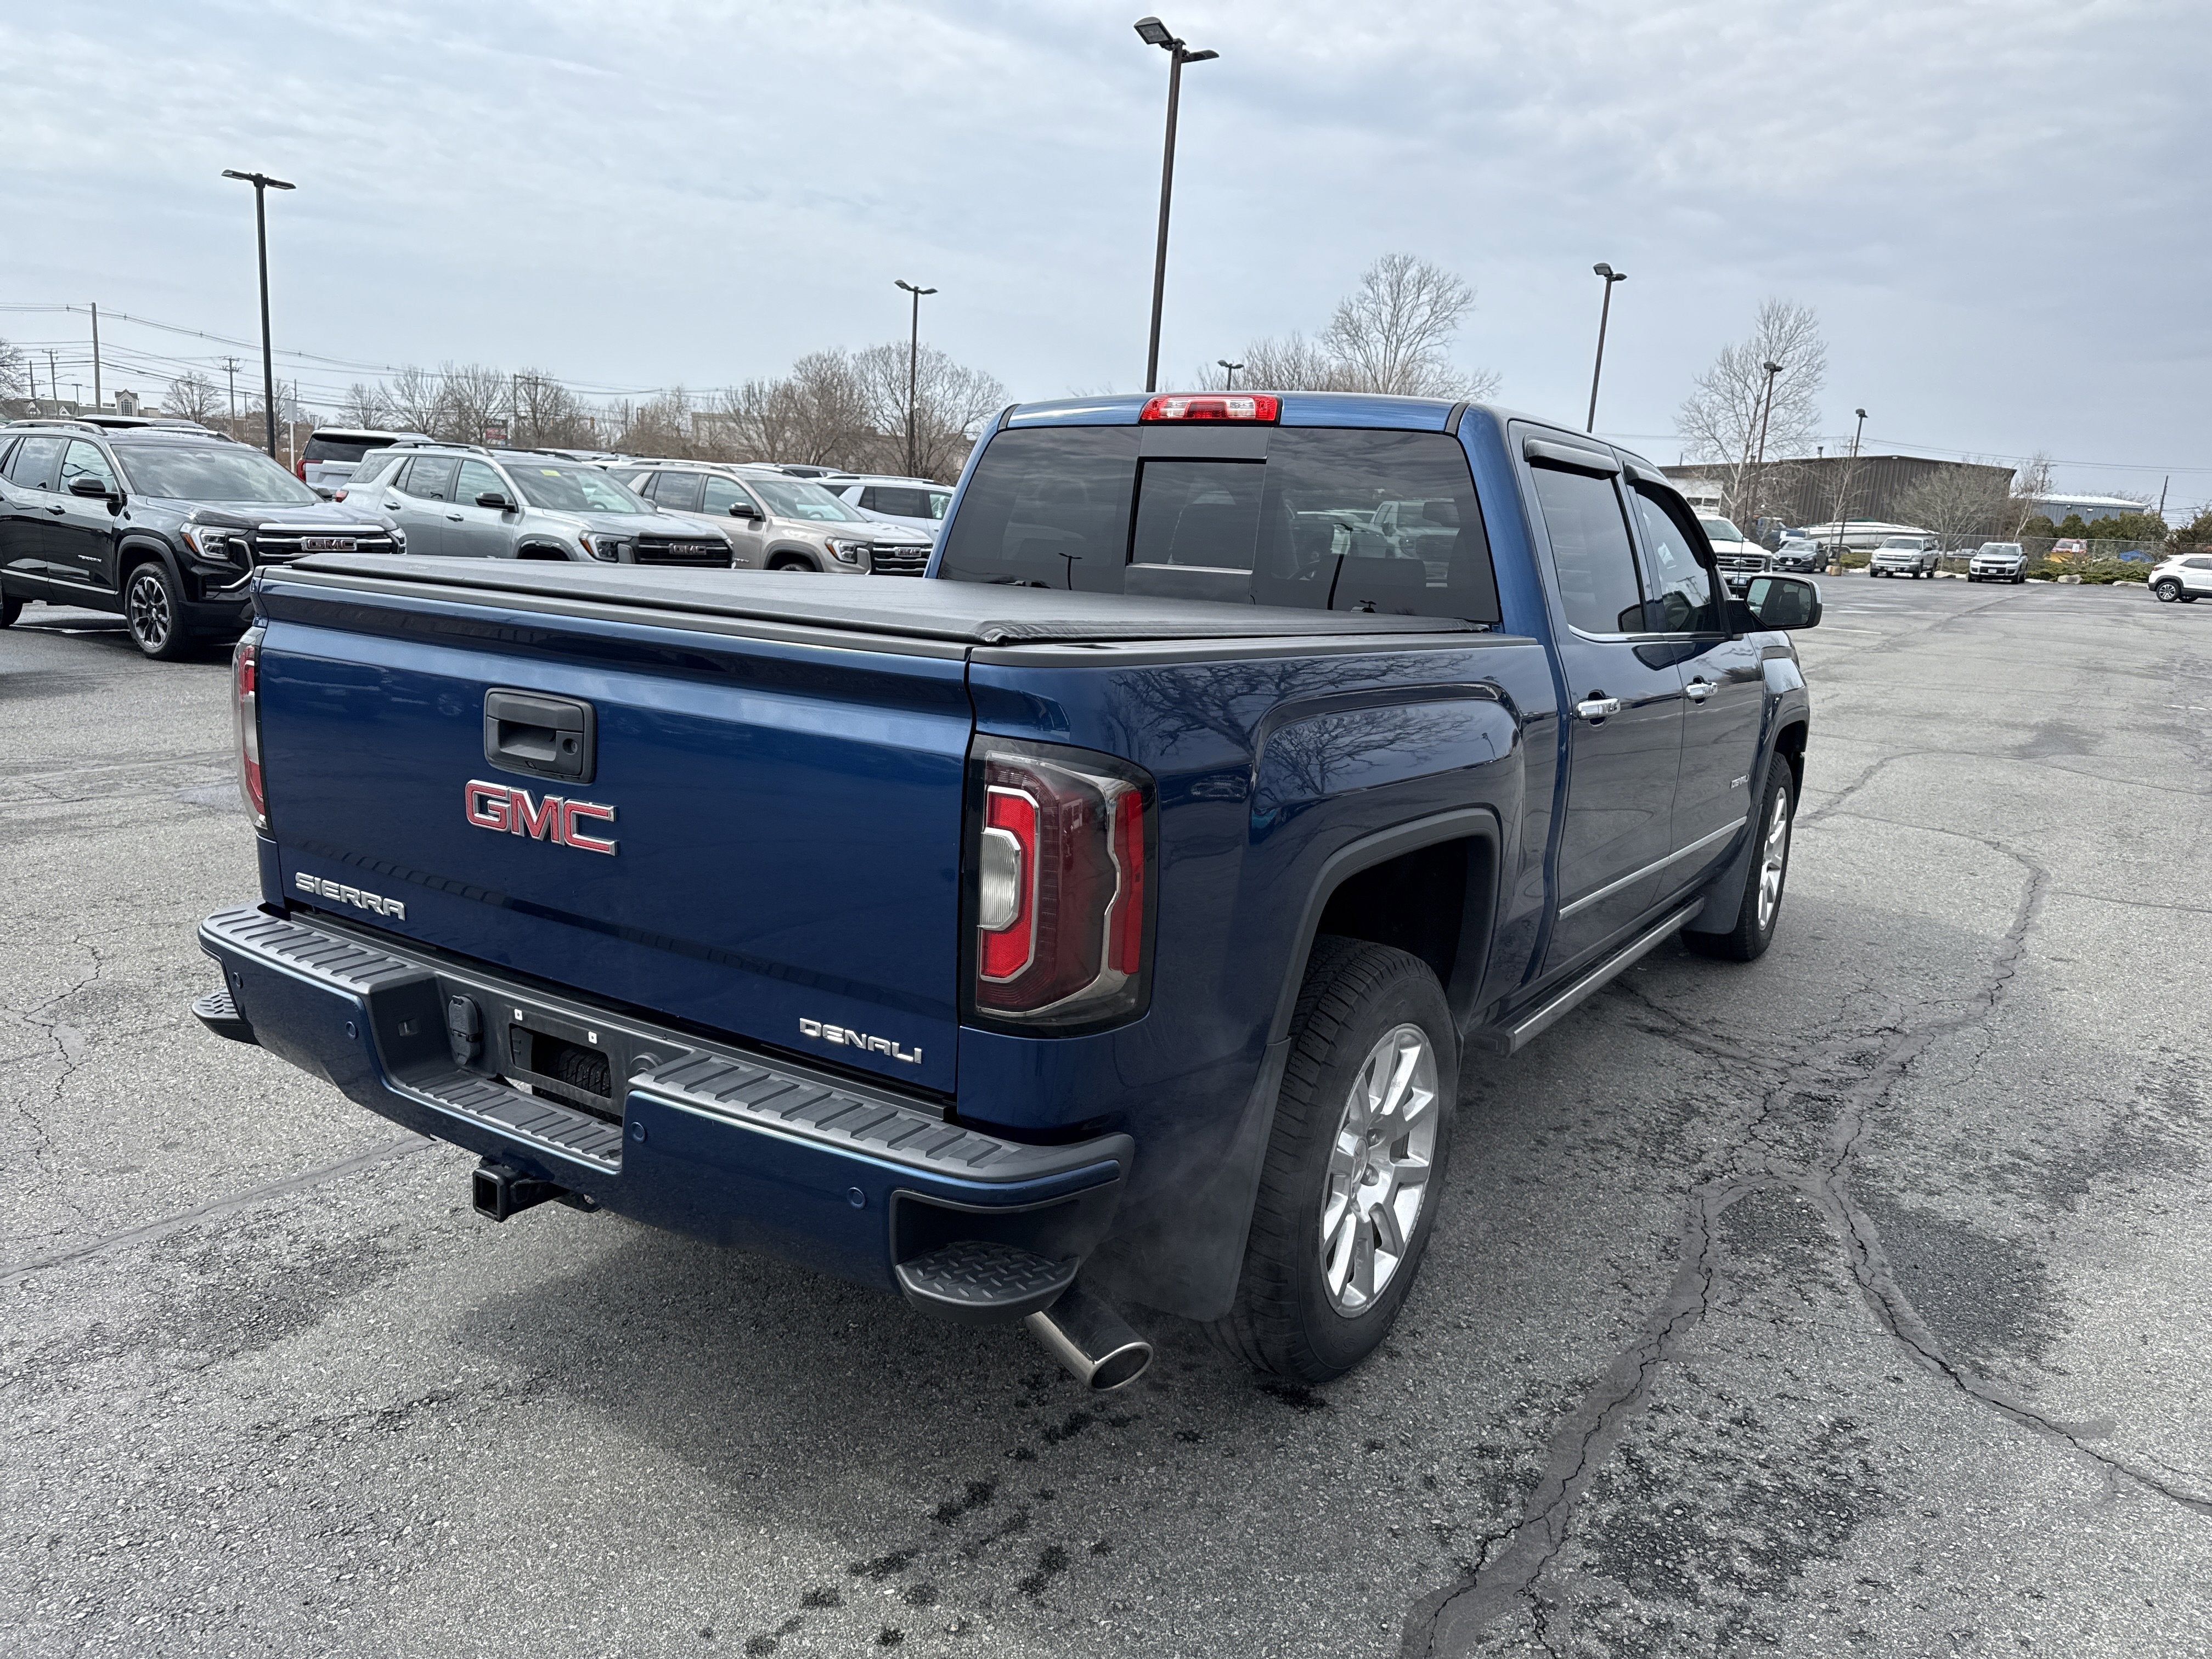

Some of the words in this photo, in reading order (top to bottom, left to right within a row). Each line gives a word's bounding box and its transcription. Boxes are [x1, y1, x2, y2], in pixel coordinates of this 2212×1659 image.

[306, 538, 356, 550] GMC
[673, 544, 707, 555] GMC
[898, 548, 921, 556] GMC
[465, 779, 618, 856] GMC
[295, 871, 406, 922] SIERRA
[799, 1017, 922, 1064] DENALI
